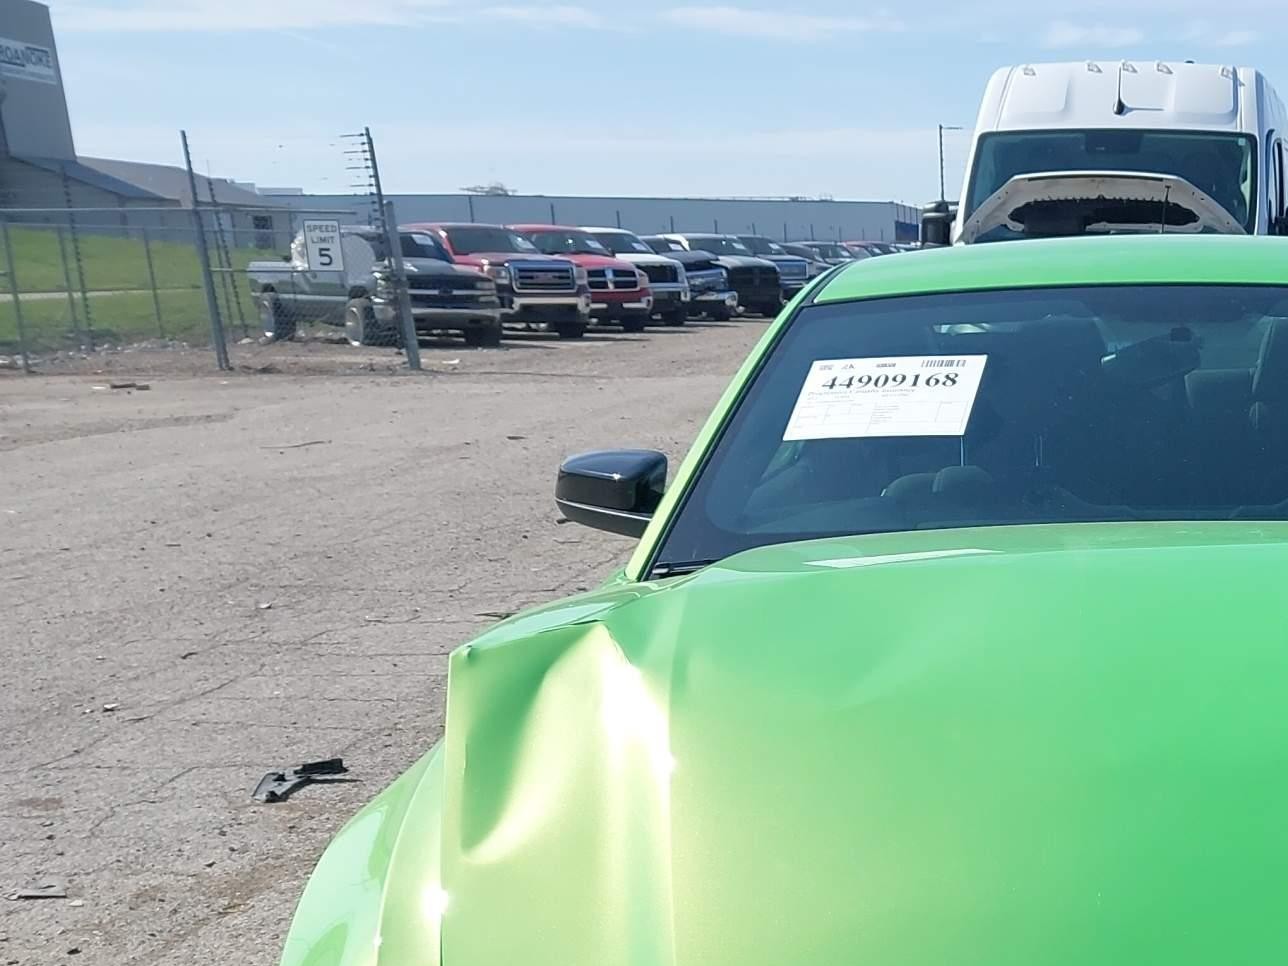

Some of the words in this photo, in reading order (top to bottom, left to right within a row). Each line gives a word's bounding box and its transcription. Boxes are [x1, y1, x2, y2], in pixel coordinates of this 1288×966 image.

[306, 224, 337, 233] SPEED
[311, 236, 335, 244] LIMIT
[318, 247, 333, 266] 5
[821, 372, 960, 391] 44909168
